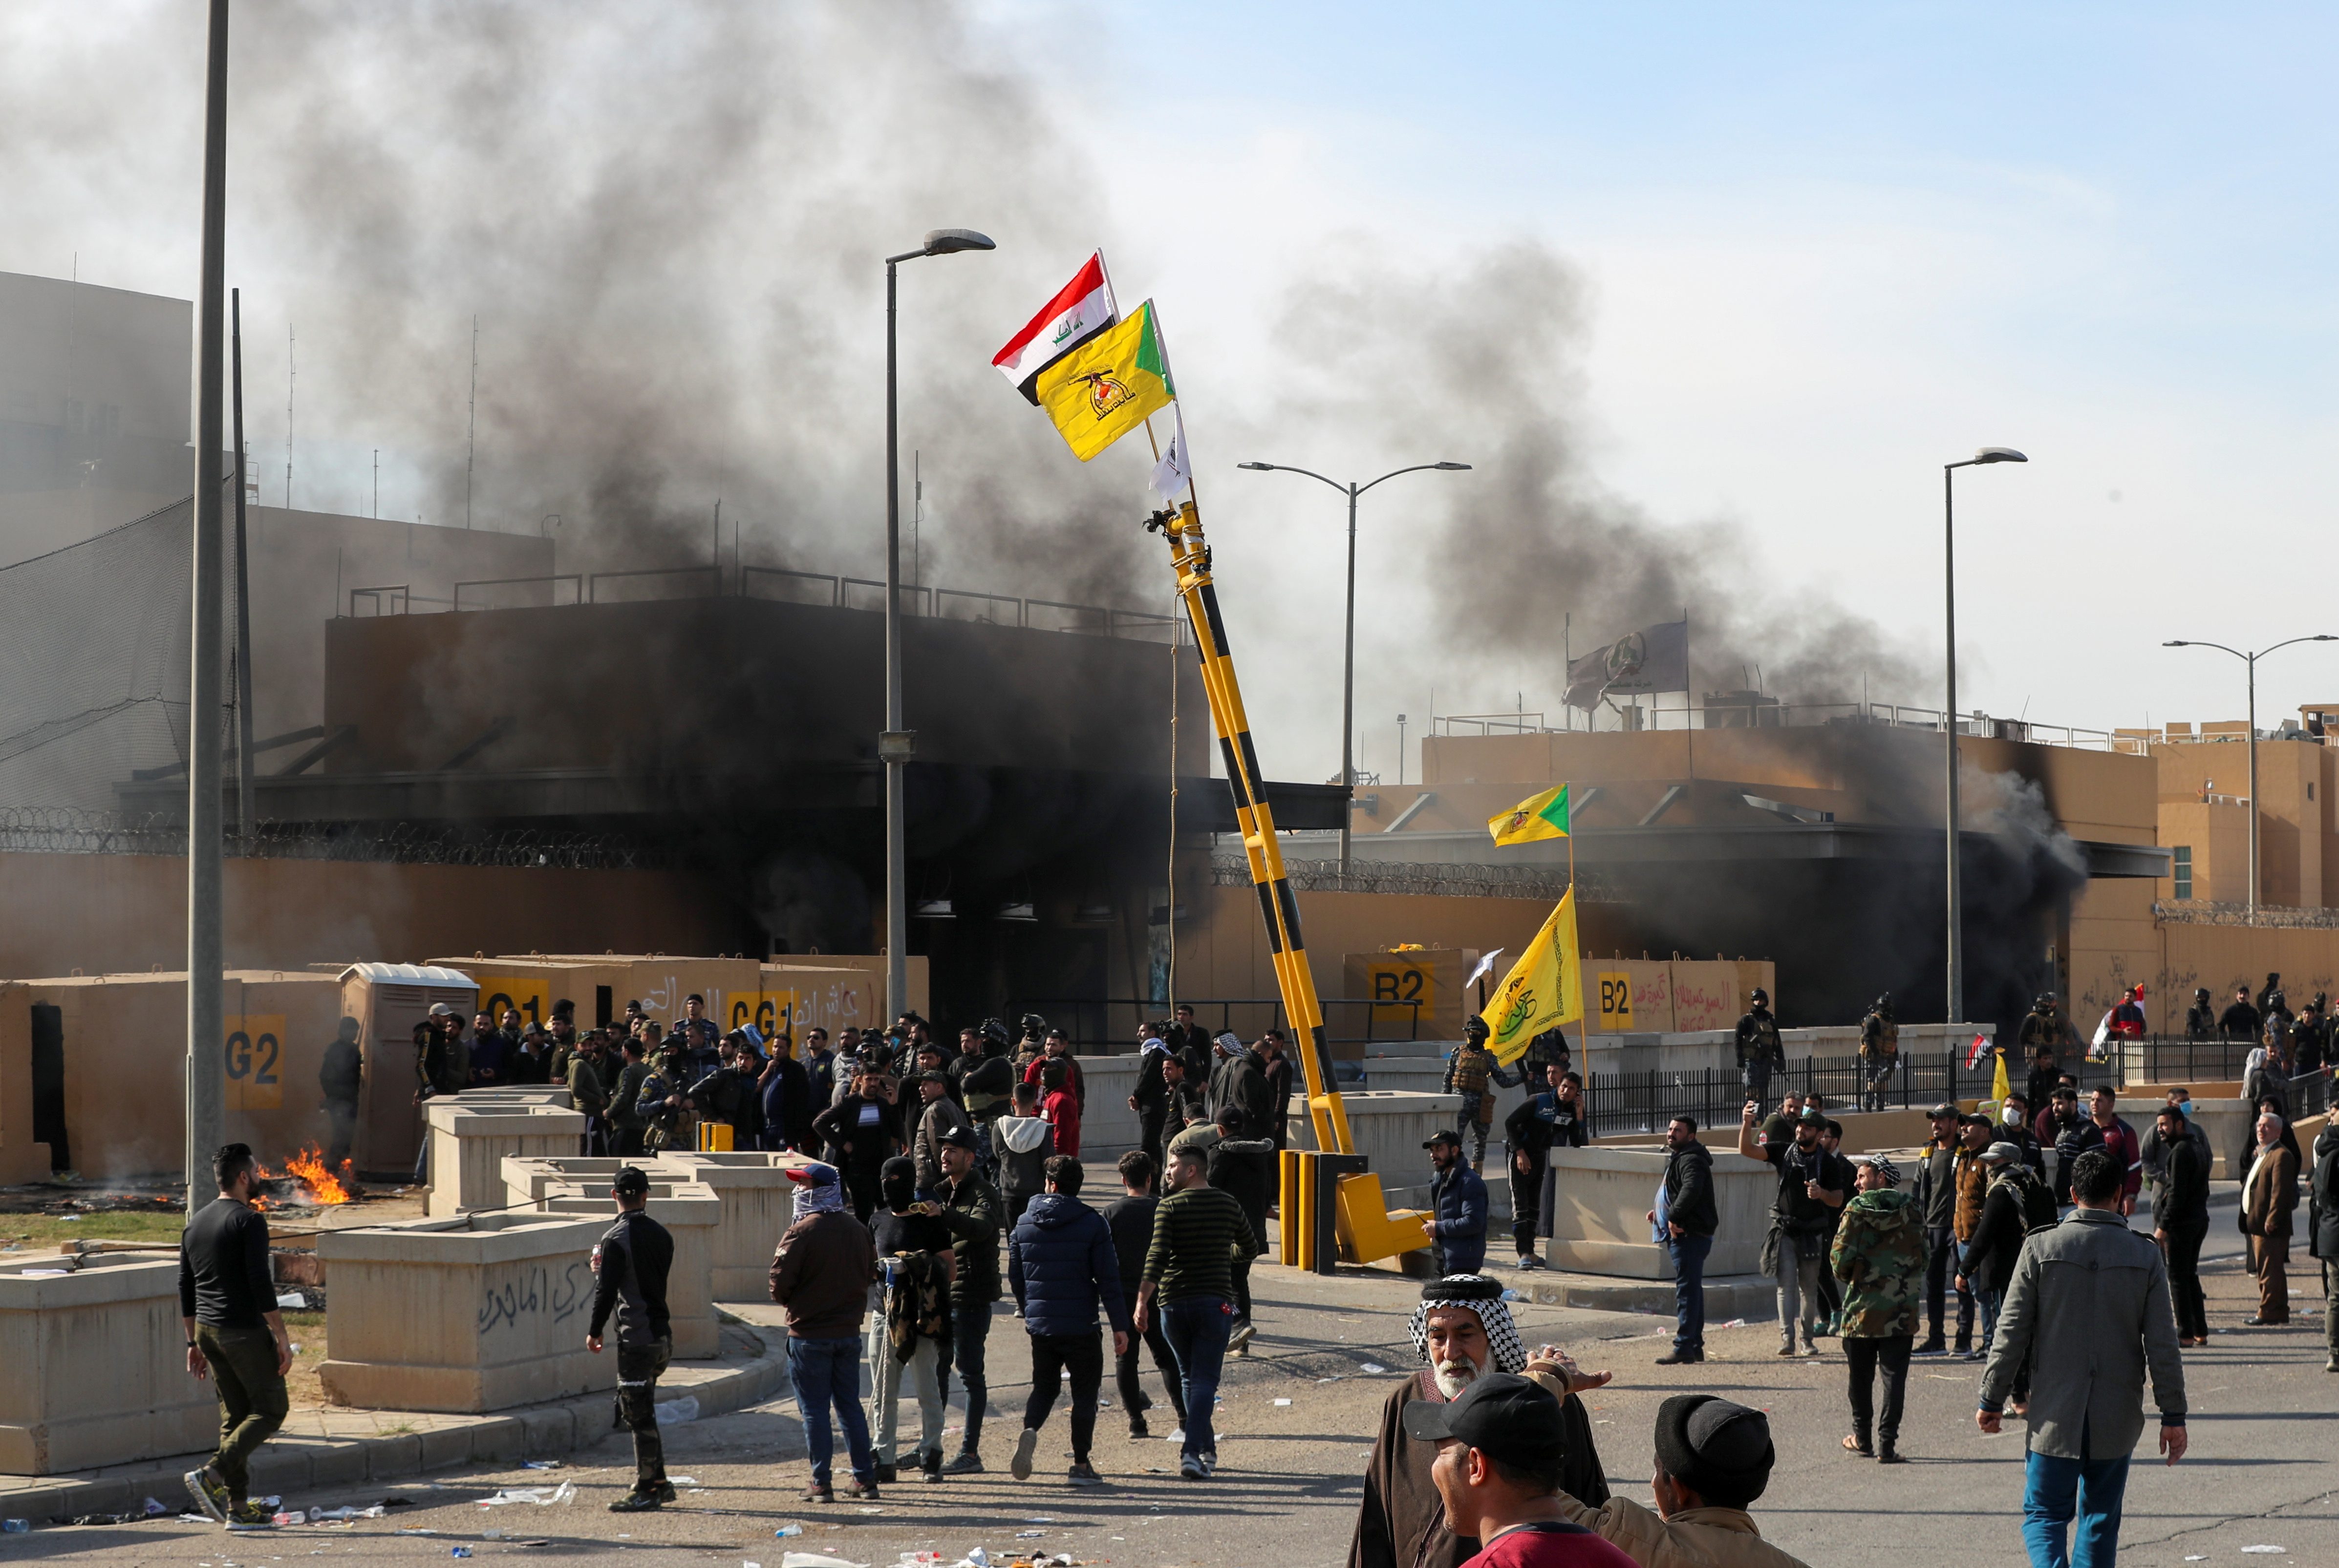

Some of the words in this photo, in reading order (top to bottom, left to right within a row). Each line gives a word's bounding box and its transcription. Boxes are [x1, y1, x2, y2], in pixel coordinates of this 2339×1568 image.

[820, 982, 858, 1031] عاش
[1375, 970, 1423, 1006] B2
[1602, 980, 1629, 1014] B2
[225, 1031, 279, 1084] G2
